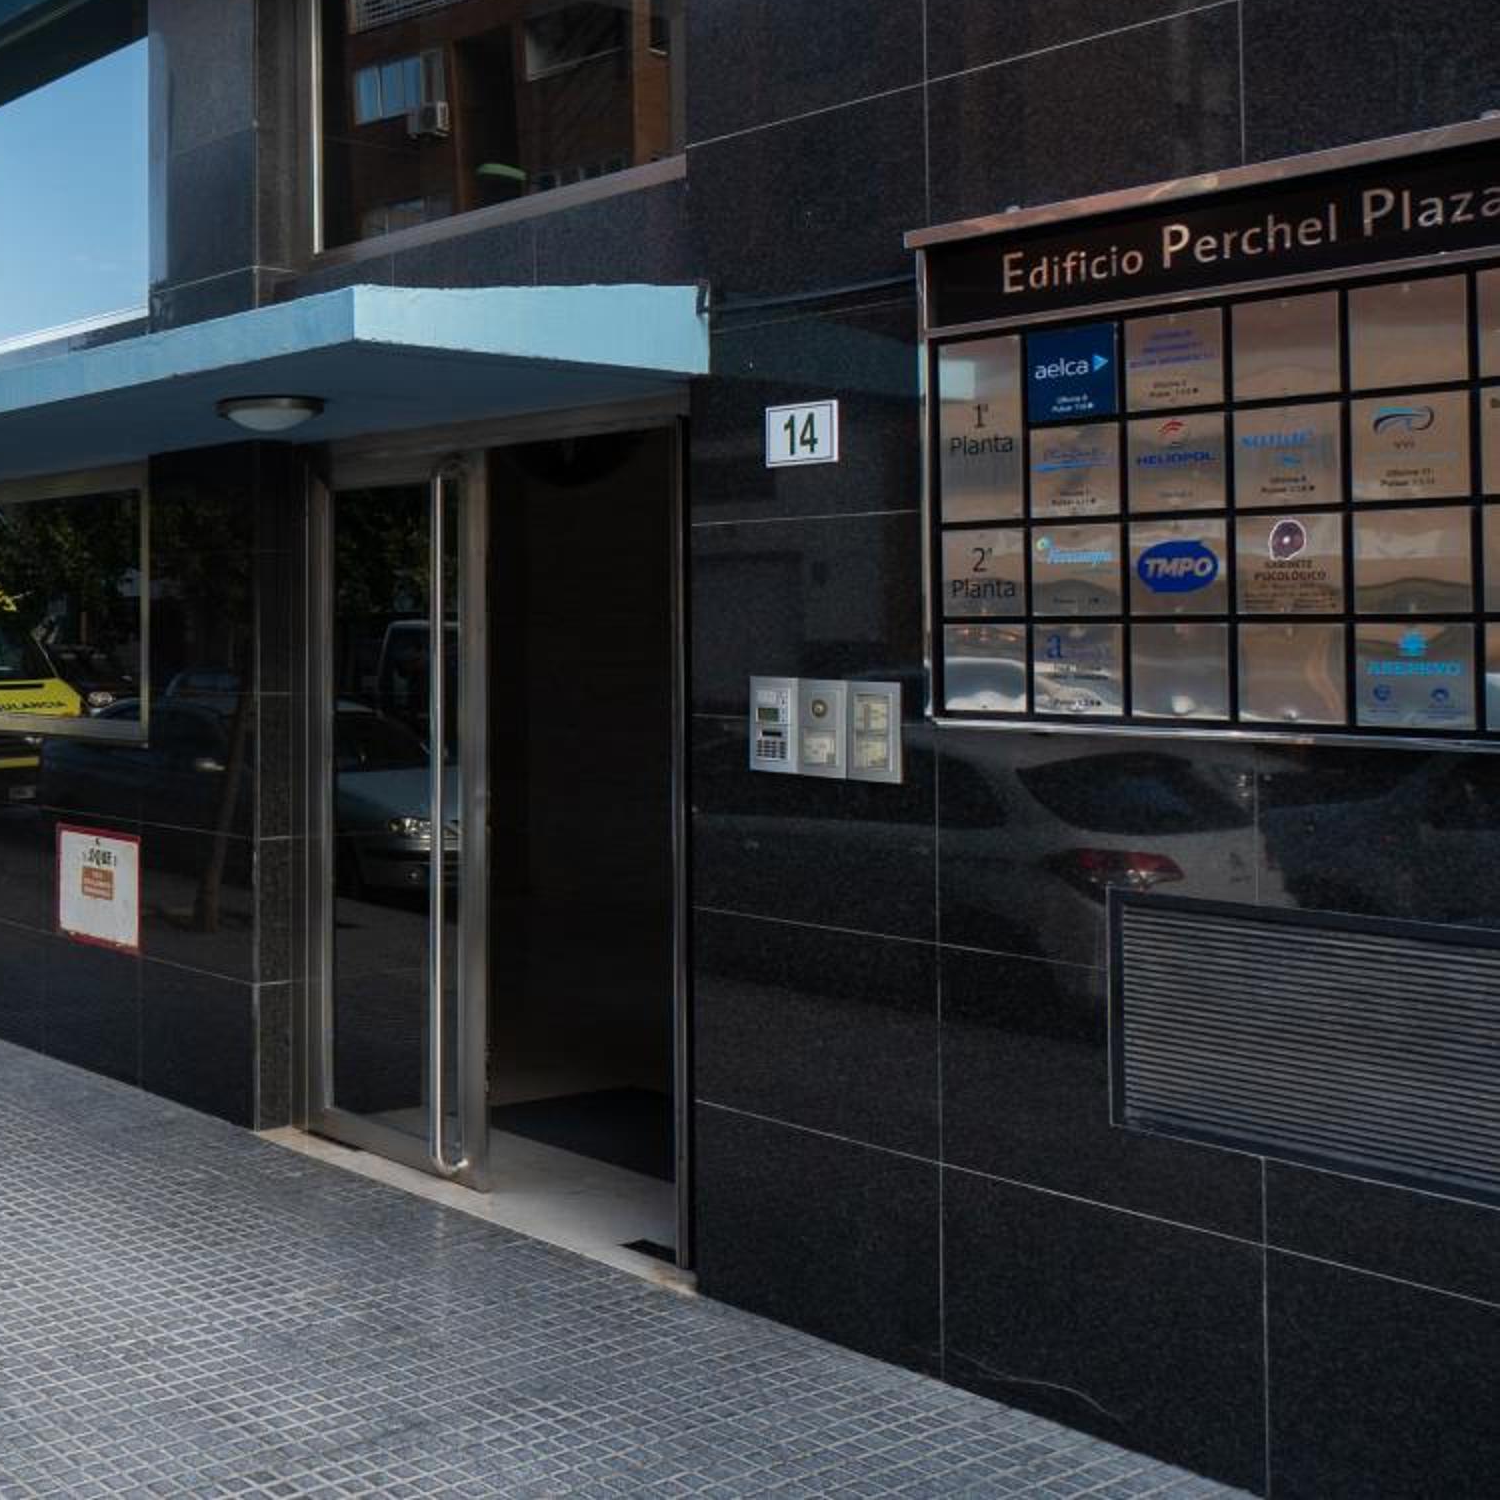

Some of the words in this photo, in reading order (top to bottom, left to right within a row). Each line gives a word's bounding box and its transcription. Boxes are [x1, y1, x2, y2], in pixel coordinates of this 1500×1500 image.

[1002, 246, 1144, 294] Edificio
[1161, 203, 1338, 269] Perchel
[1361, 185, 1500, 237] Plaza
[1034, 357, 1089, 380] aelca
[784, 412, 818, 456] 14
[950, 435, 1014, 456] Planta
[1144, 556, 1213, 579] TMPO
[951, 577, 1016, 599] Planta
